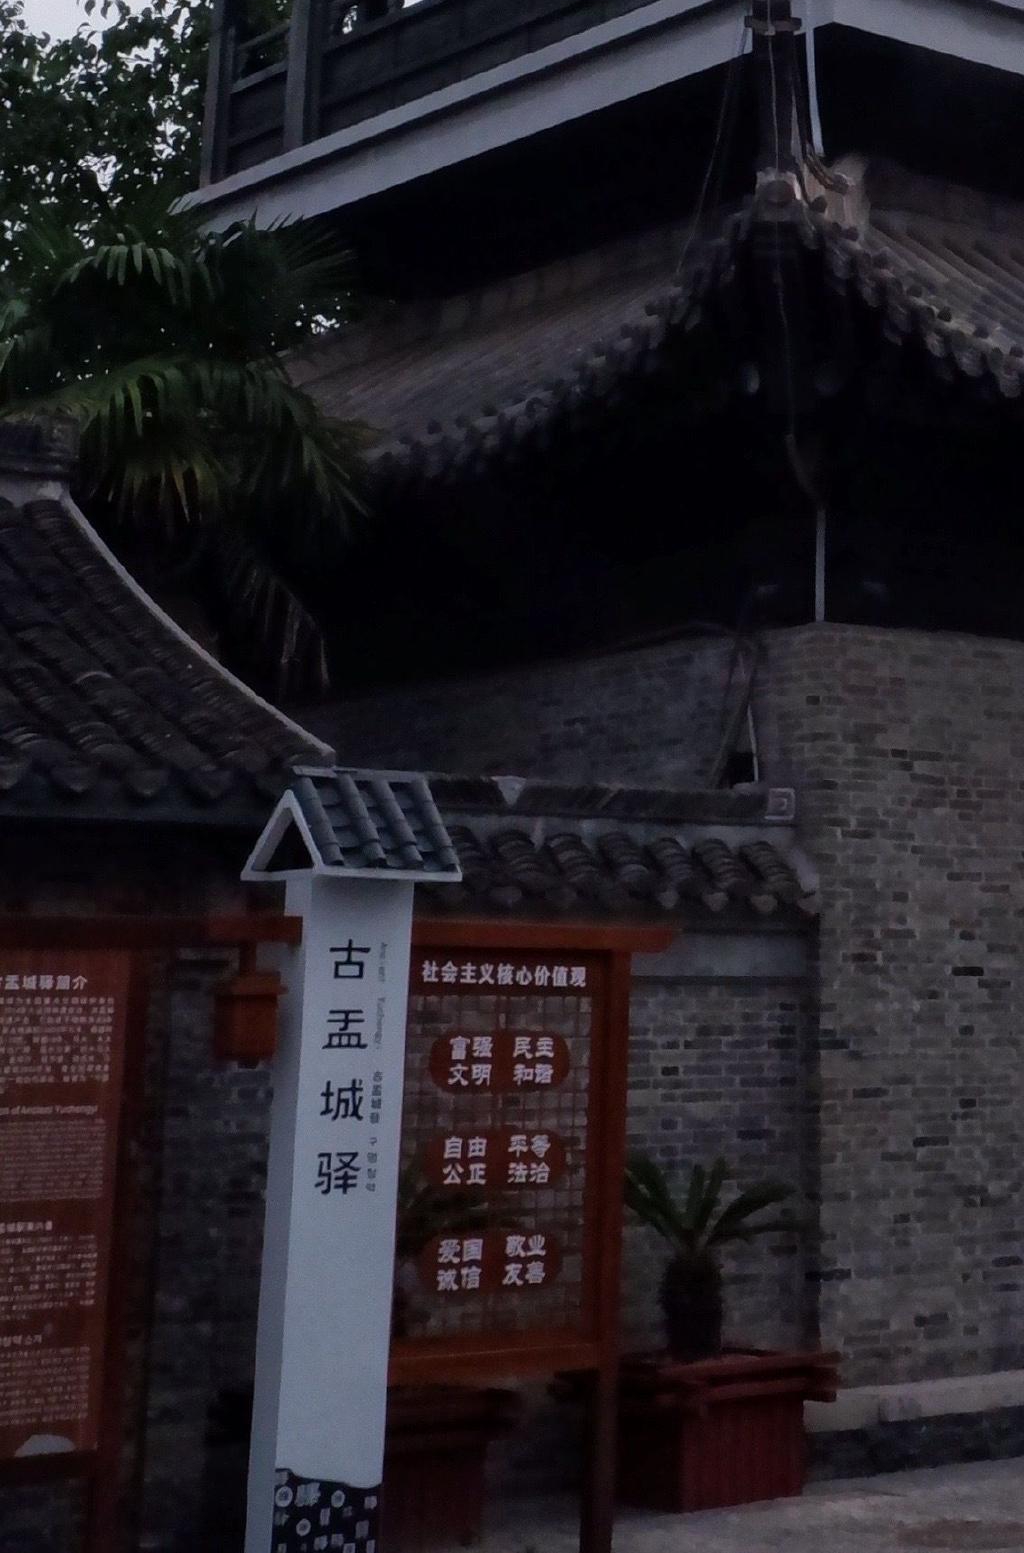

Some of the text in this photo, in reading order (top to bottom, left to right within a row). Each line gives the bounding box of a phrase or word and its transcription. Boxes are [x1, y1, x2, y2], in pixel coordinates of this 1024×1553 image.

[422, 960, 587, 988] 社会主义核心价值观
[449, 1036, 555, 1060] 富强 民主
[447, 1063, 554, 1087] 文明 和谐
[443, 1134, 551, 1160] 自由 平等
[443, 1161, 551, 1186] 公正 法治
[437, 1234, 547, 1265] 爱国 敬业
[436, 1262, 547, 1292] 诚信 友善
